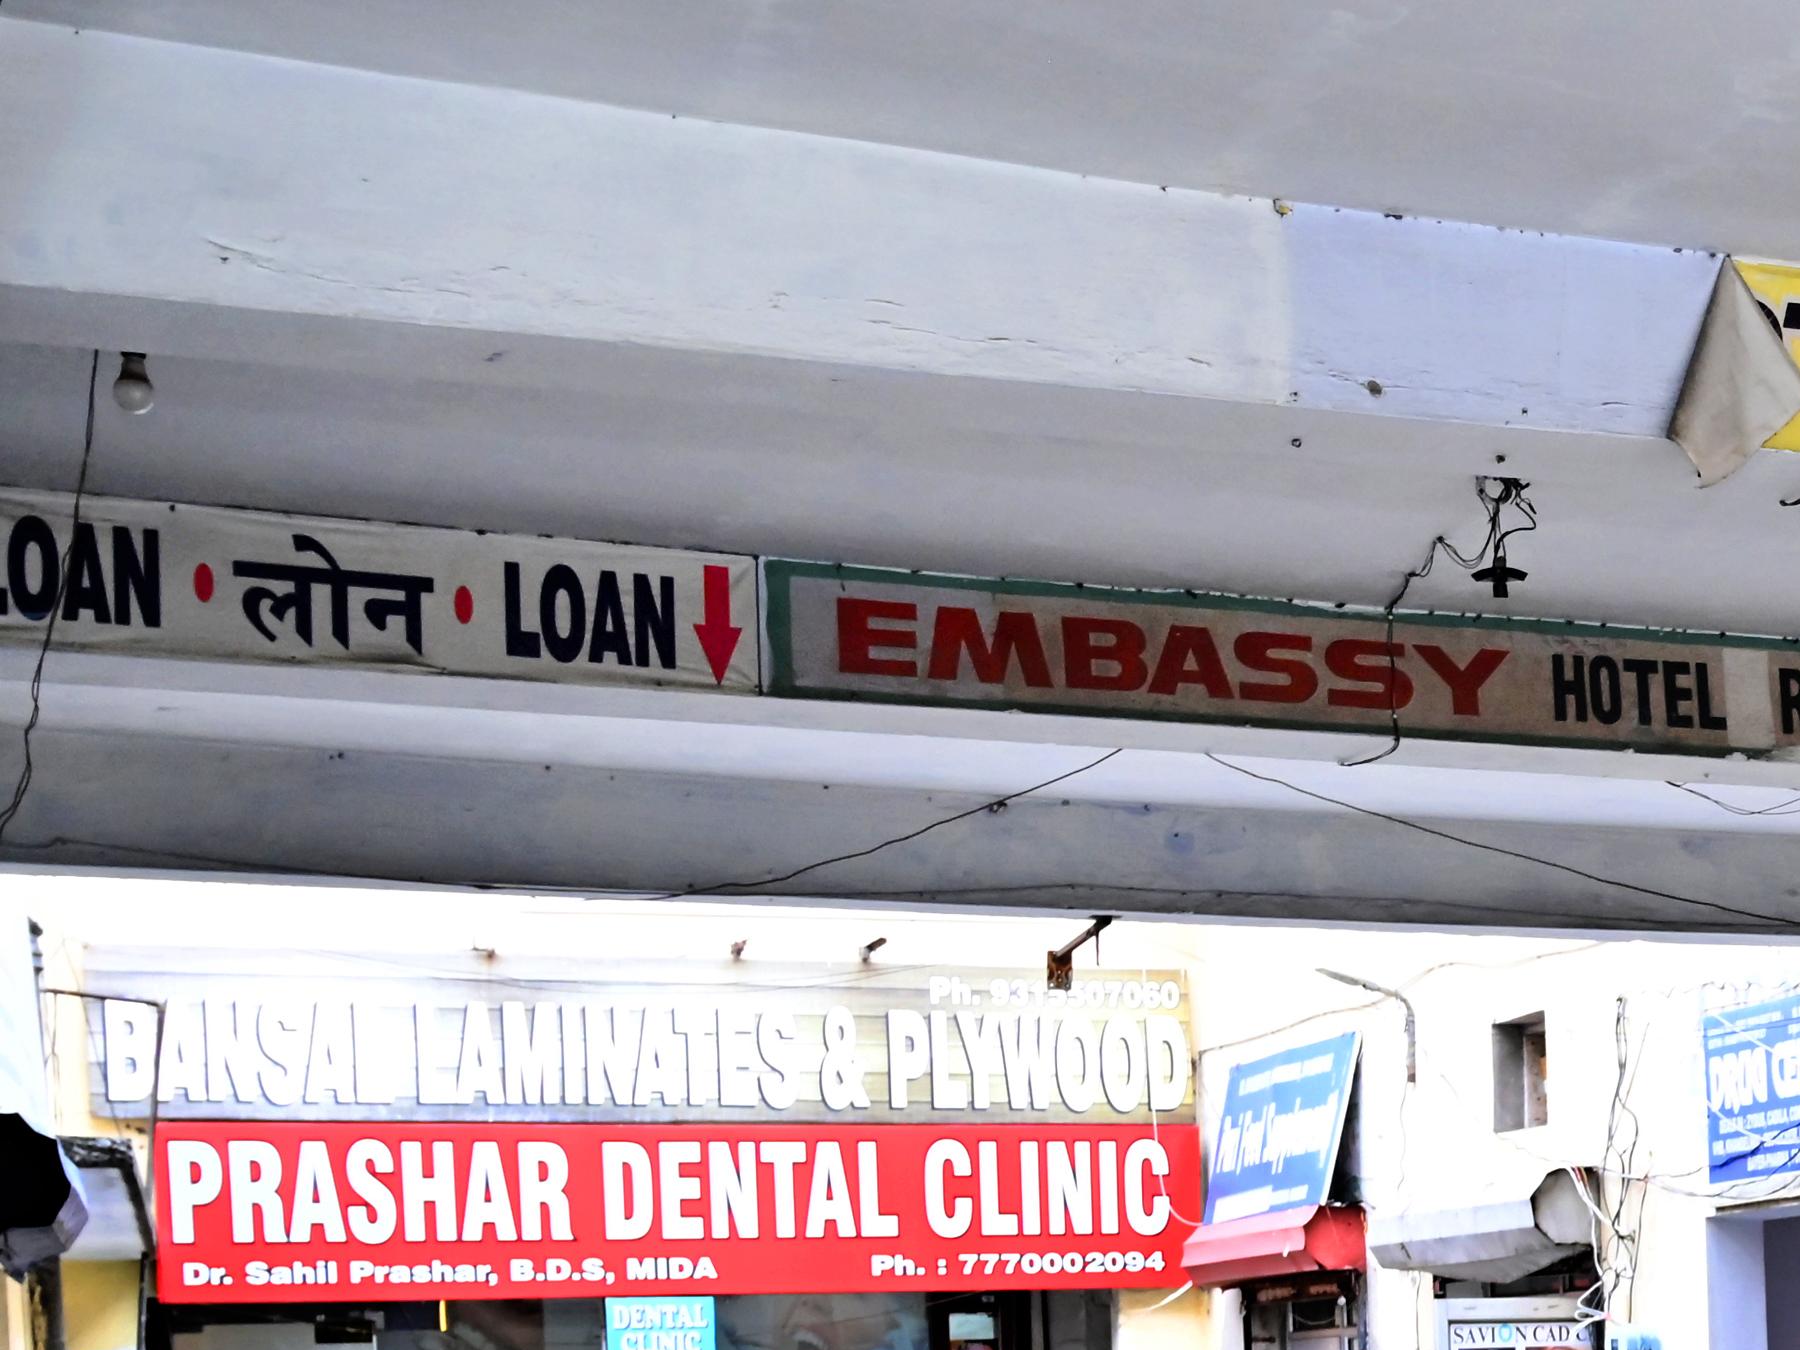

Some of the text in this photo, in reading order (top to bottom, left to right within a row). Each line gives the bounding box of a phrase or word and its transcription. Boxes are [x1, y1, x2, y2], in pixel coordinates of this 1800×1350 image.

[0, 515, 161, 628] OAN
[232, 534, 434, 656] लोन
[503, 560, 677, 669] LOAN
[836, 597, 1510, 716] EMBASSY
[1551, 653, 1728, 731] HOTEL
[103, 997, 396, 1107] BANSAL
[414, 999, 800, 1110] LAMINATES
[819, 1004, 871, 1111] &
[887, 1008, 1189, 1112] PLYWOOD
[166, 1138, 576, 1245] PRASHAR
[600, 1140, 900, 1241] DENTAL
[923, 1138, 1171, 1238] CLINIC
[183, 1261, 233, 1286] Dr.
[245, 1259, 338, 1286] Sahil
[350, 1258, 499, 1287] Prashar,
[627, 1256, 718, 1280] MIDA
[613, 1303, 709, 1330] DENTAL
[870, 1253, 925, 1277] Ph.
[957, 1250, 1166, 1275] 7770002094
[1453, 1323, 1527, 1344] SAVION
[1533, 1324, 1571, 1343] CAD
